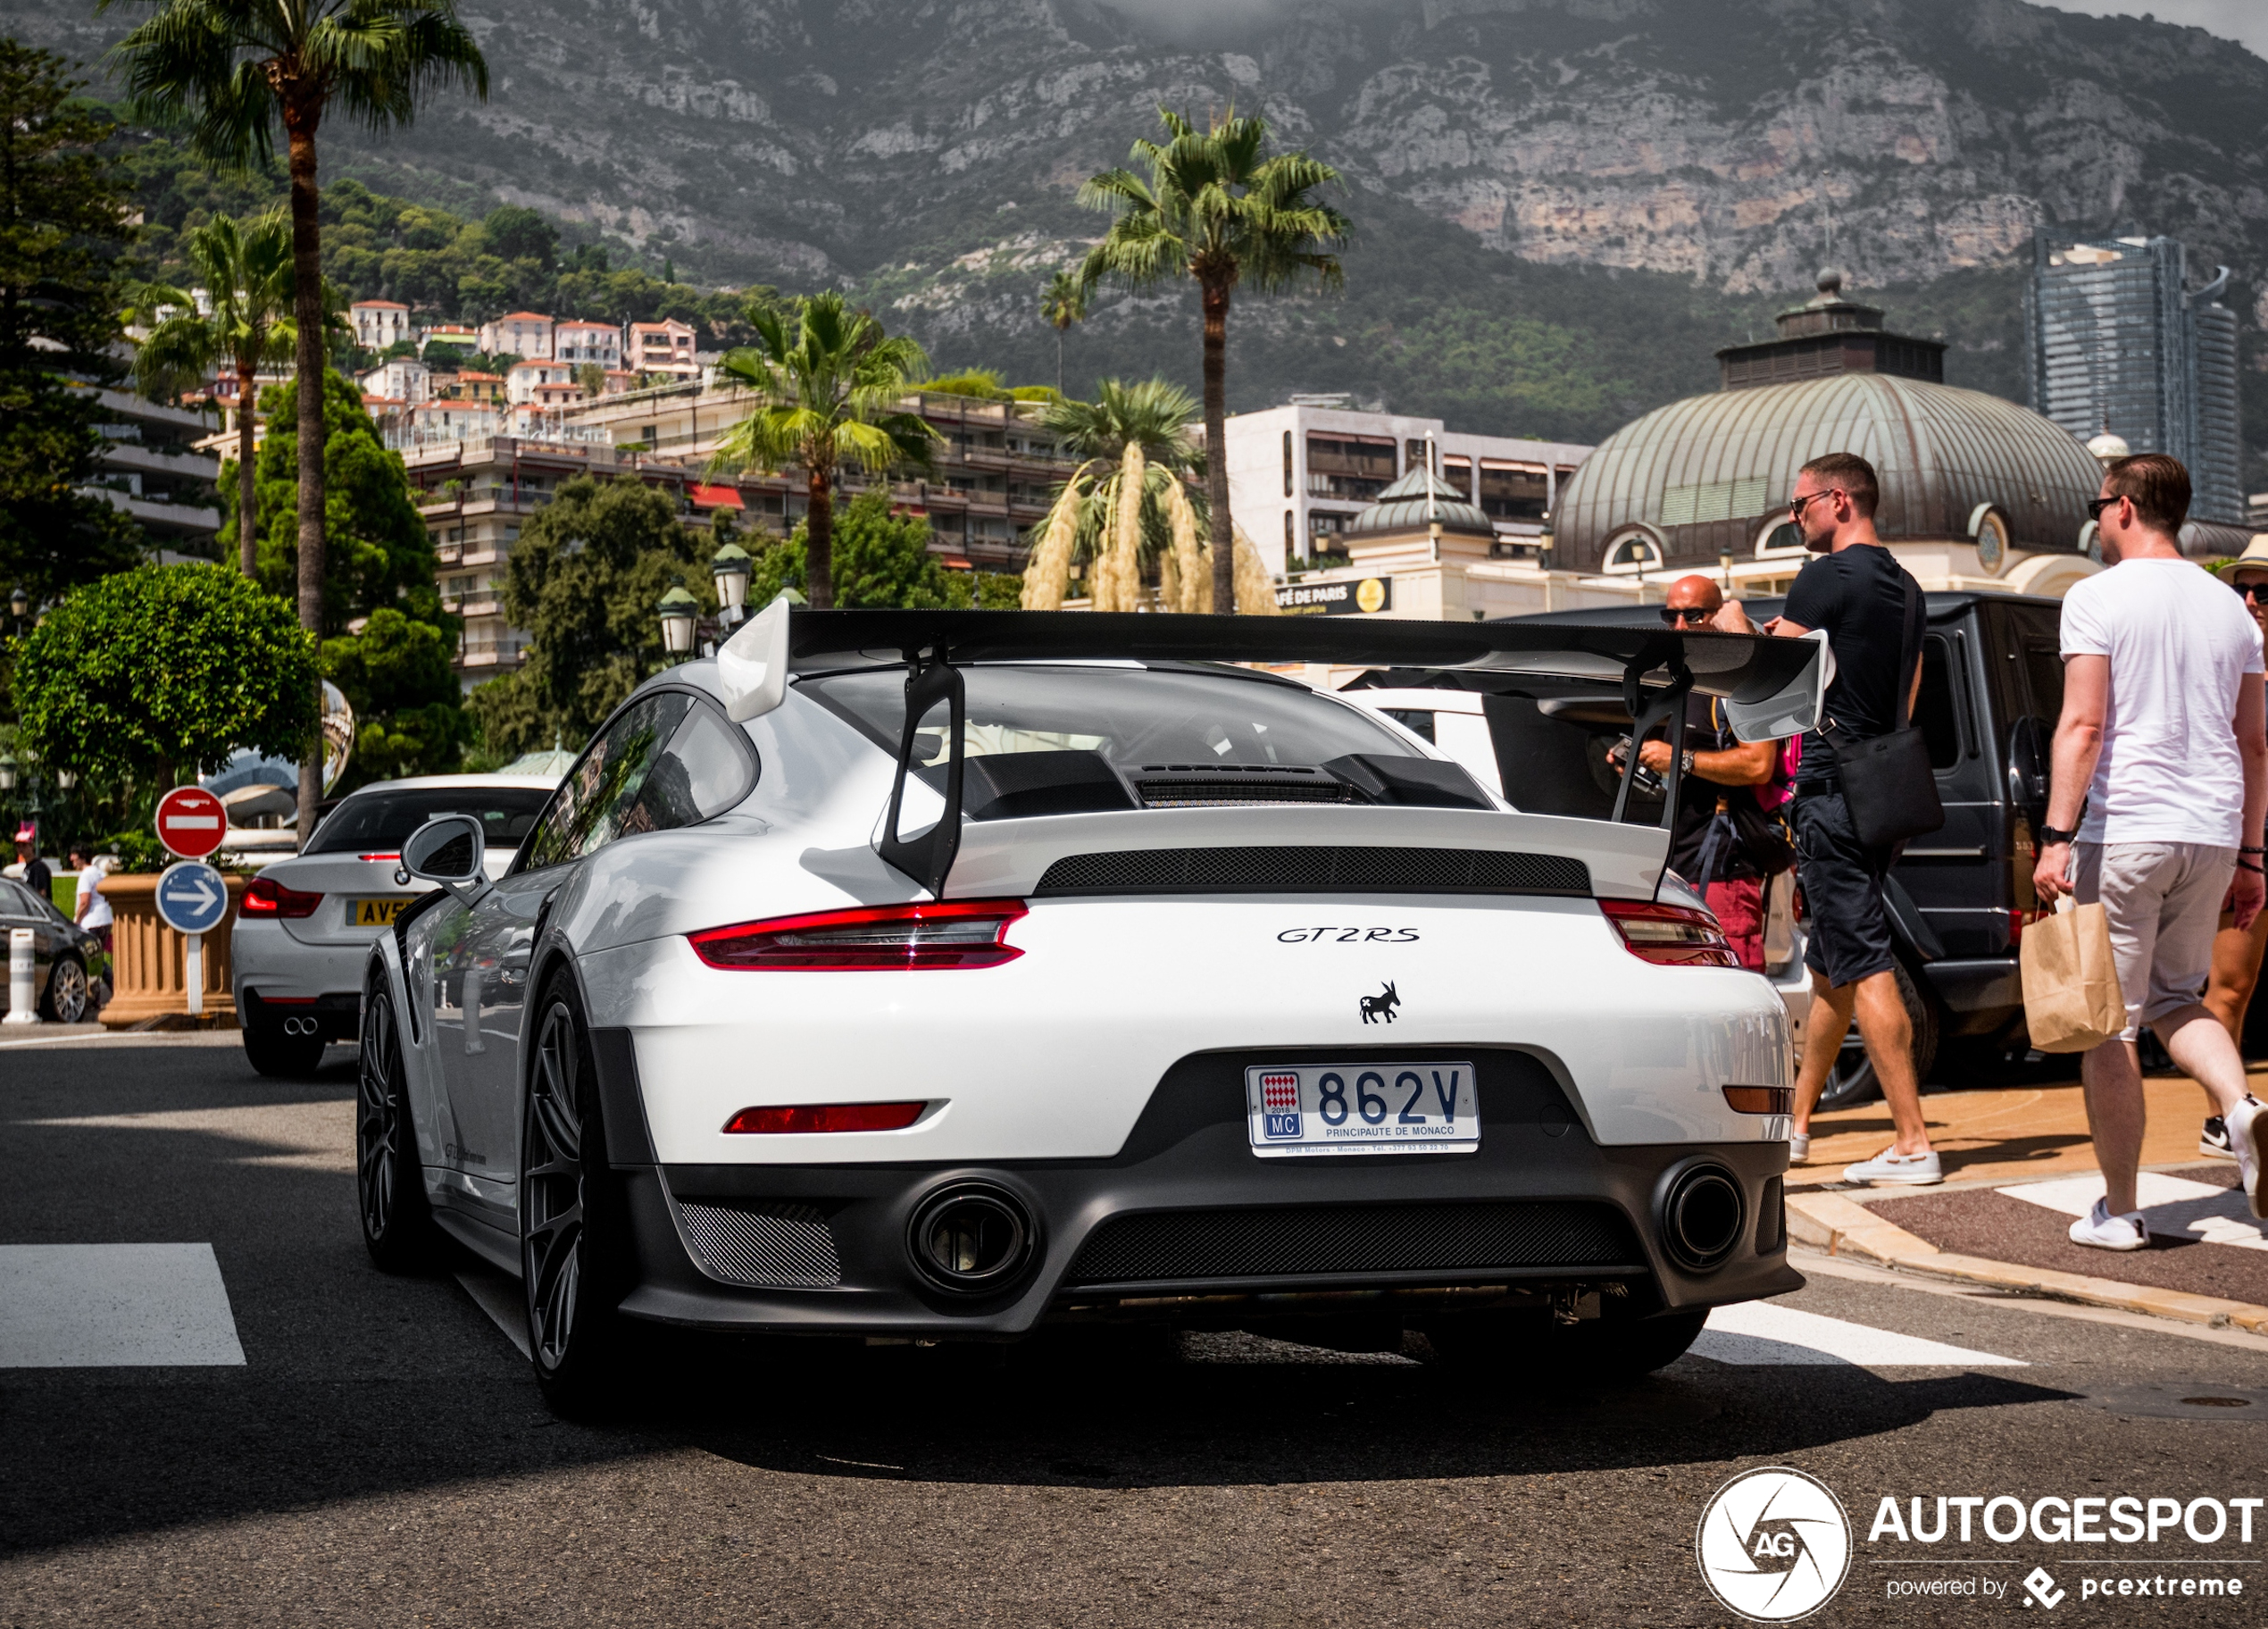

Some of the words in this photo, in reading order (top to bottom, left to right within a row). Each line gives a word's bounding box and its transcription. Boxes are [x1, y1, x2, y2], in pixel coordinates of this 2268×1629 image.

[1274, 588, 1294, 606] AFÉ
[1295, 589, 1312, 605] DE
[1313, 585, 1347, 603] PARIS
[363, 902, 409, 923] AV5
[1318, 1071, 1459, 1126] 862V
[1272, 1116, 1295, 1133] MC
[1326, 1127, 1391, 1137] PRINCIPAUTE
[1396, 1126, 1408, 1135] DE
[1413, 1126, 1455, 1135] MONACO
